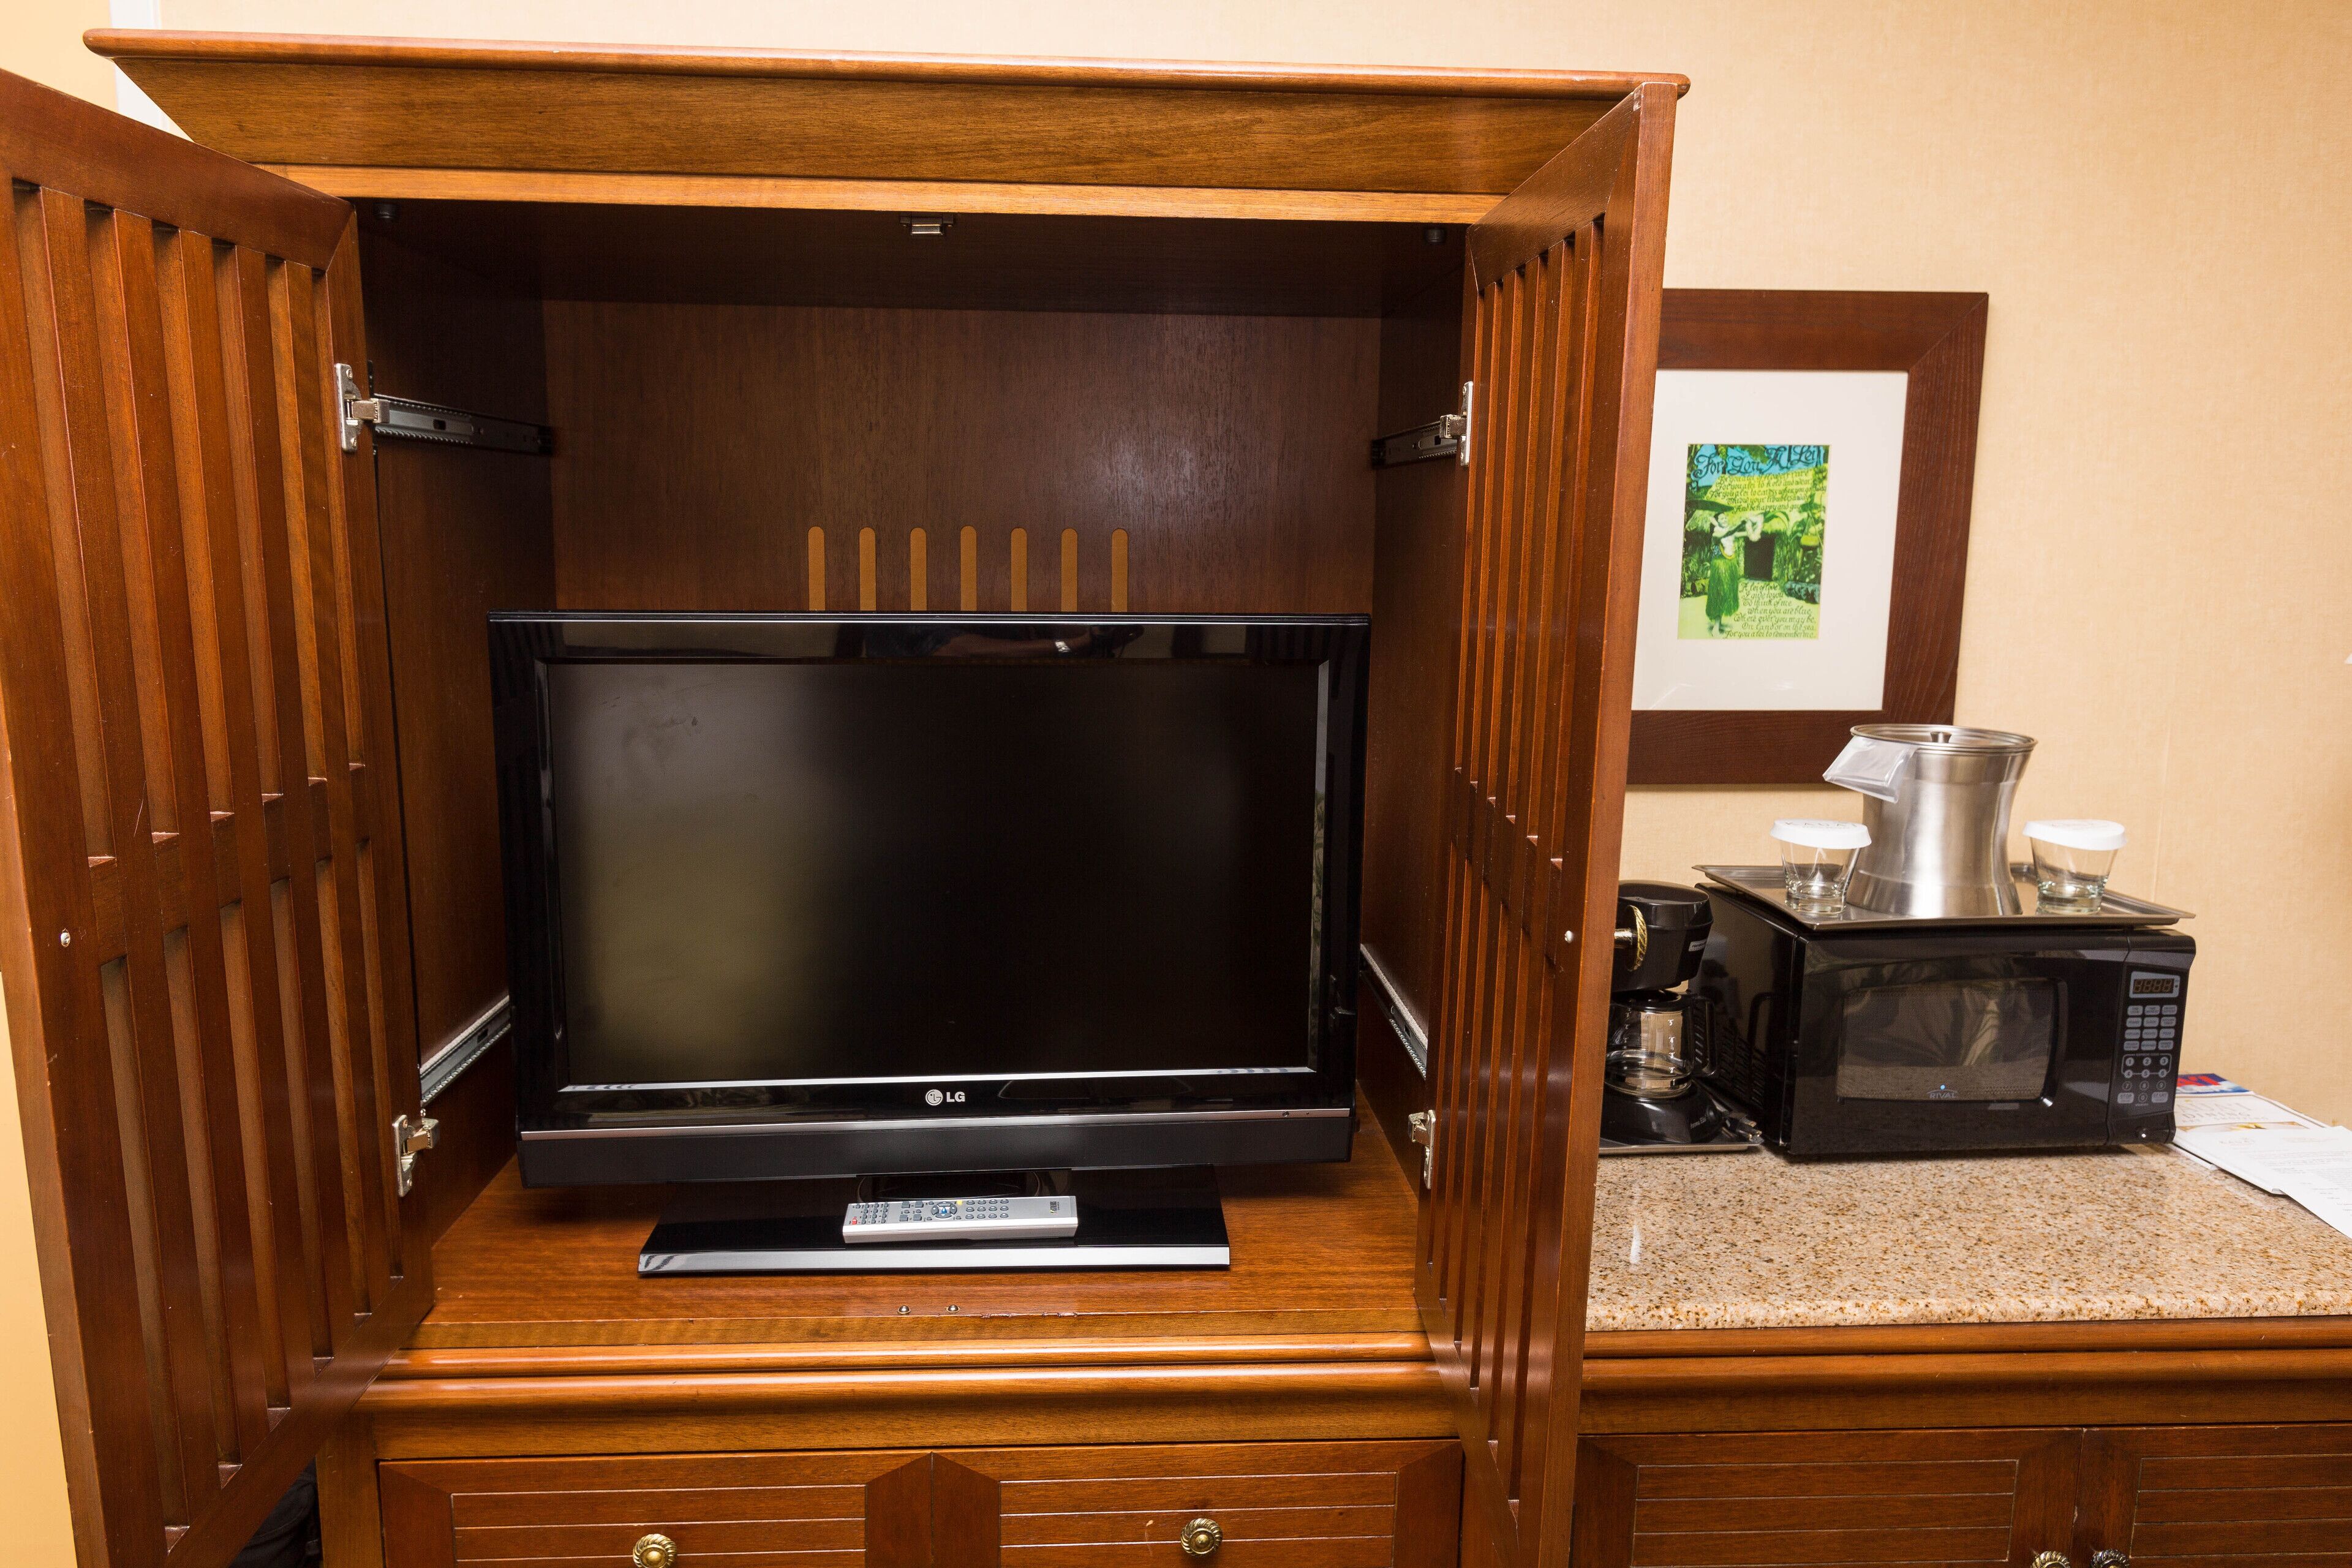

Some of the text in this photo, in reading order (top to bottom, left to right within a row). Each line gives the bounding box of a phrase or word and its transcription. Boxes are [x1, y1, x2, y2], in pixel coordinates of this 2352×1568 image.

[1691, 454, 1724, 480] For
[1790, 445, 1815, 466] Lei
[1716, 480, 1729, 490] For
[1706, 491, 1720, 500] For
[1733, 503, 1749, 514] And
[1757, 503, 1776, 513] happy
[1777, 501, 1789, 510] and
[1740, 582, 1747, 593] A
[1751, 582, 1759, 591] lei
[1755, 622, 1774, 631] land
[946, 1091, 965, 1102] LG
